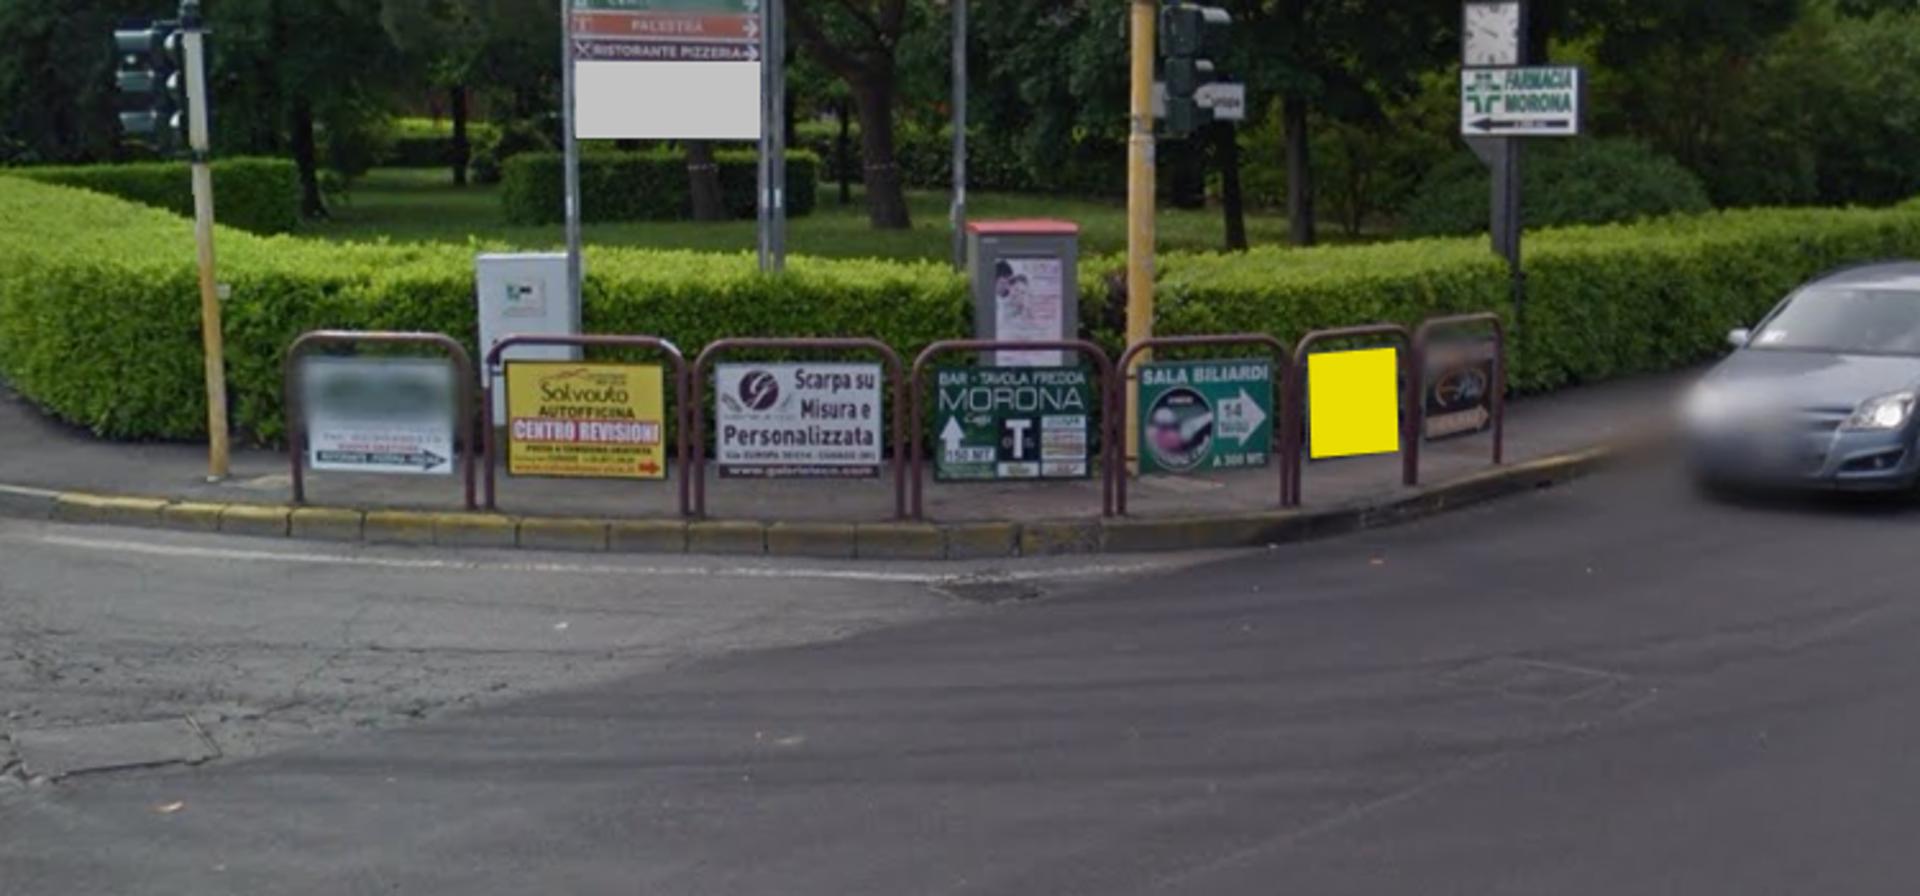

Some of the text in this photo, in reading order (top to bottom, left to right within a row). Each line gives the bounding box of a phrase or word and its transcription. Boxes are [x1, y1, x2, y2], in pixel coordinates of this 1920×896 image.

[631, 16, 704, 33] PALESTRA
[592, 44, 741, 59] RISTORANTE PIZZERIA
[1505, 69, 1572, 90] FARMACIA
[1505, 93, 1571, 112] MORONA
[795, 368, 875, 392] Scarpa su
[939, 372, 1086, 385] BAR TAVOLA FREDDA
[1142, 364, 1269, 385] SALA BILIARDI
[801, 398, 871, 420] Misura e
[938, 387, 1085, 412] MORONA
[539, 405, 636, 419] AUTOFFICINA
[513, 419, 660, 443] CENTRO REVISIONI
[723, 425, 874, 446] Personalizzata
